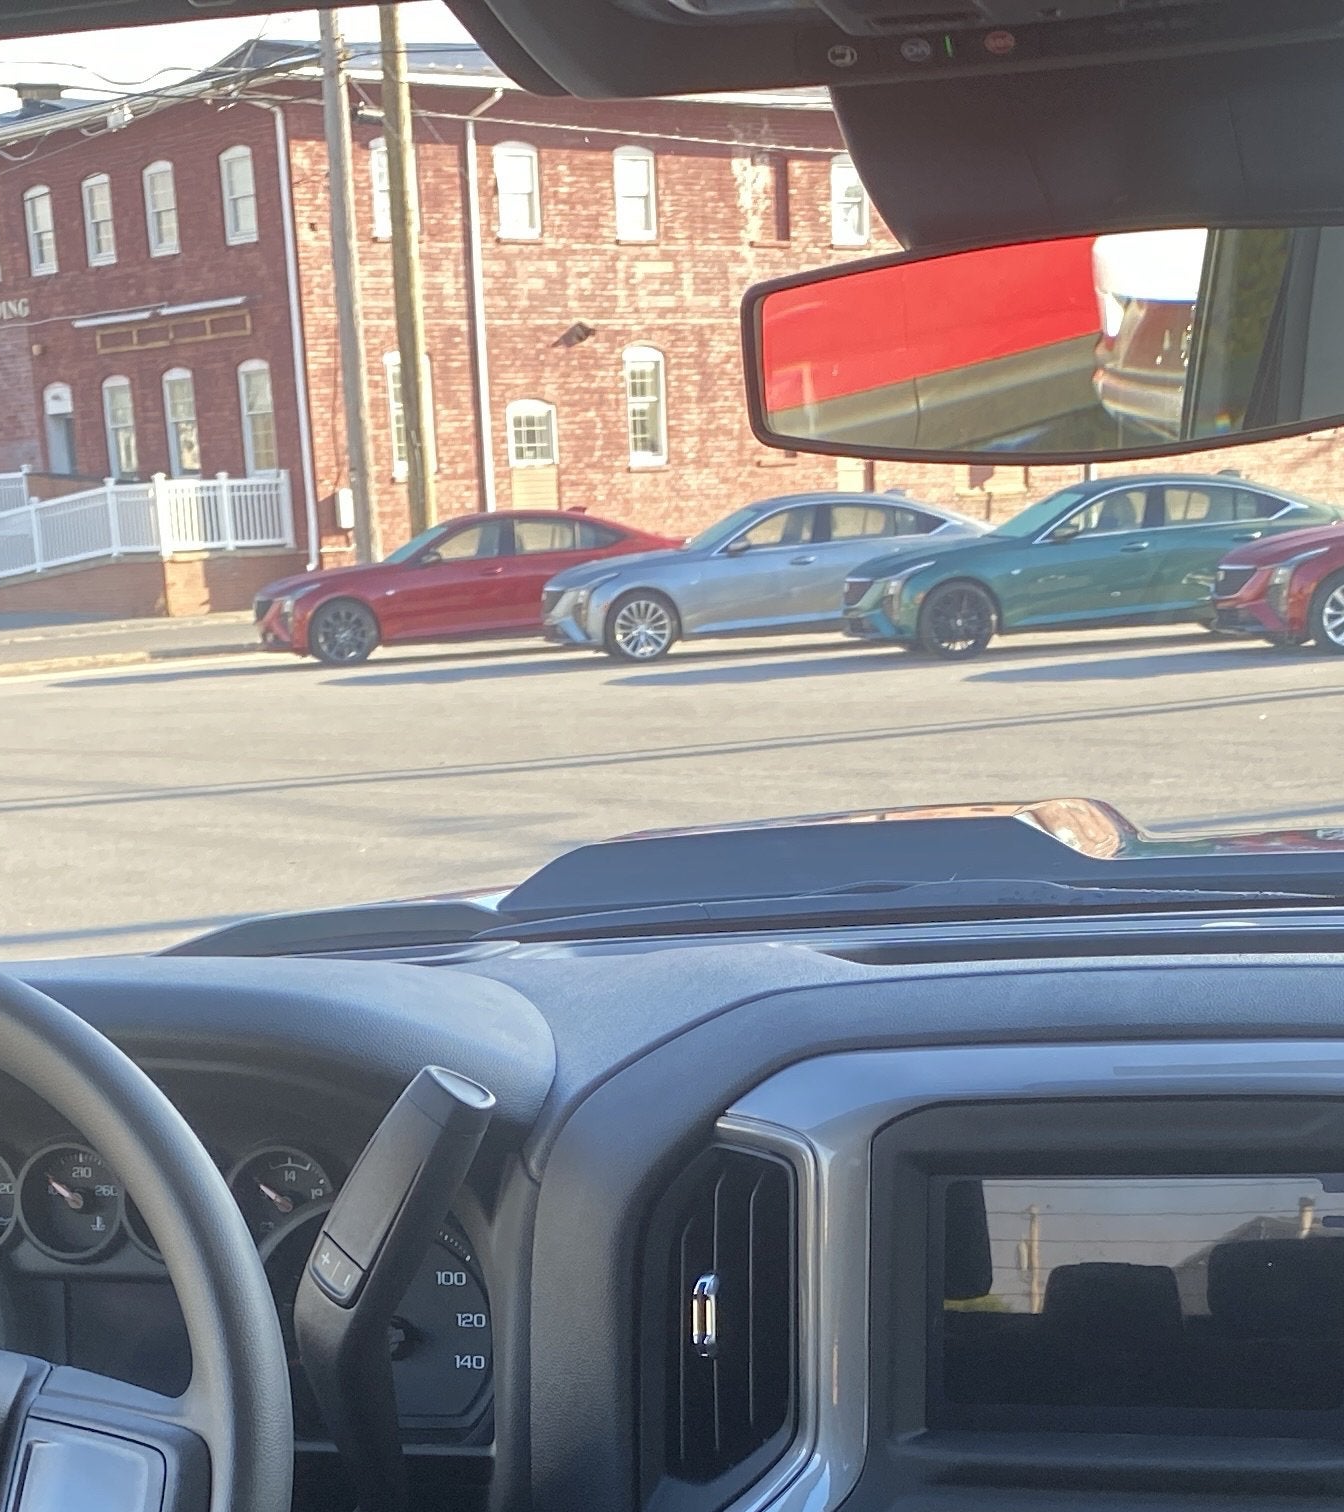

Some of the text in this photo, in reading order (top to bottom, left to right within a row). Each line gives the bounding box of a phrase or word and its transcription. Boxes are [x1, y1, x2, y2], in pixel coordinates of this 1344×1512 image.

[72, 1166, 92, 1178] 210
[284, 1170, 296, 1182] 14
[436, 1271, 467, 1286] 100
[456, 1313, 486, 1328] 120
[454, 1355, 485, 1369] 140
